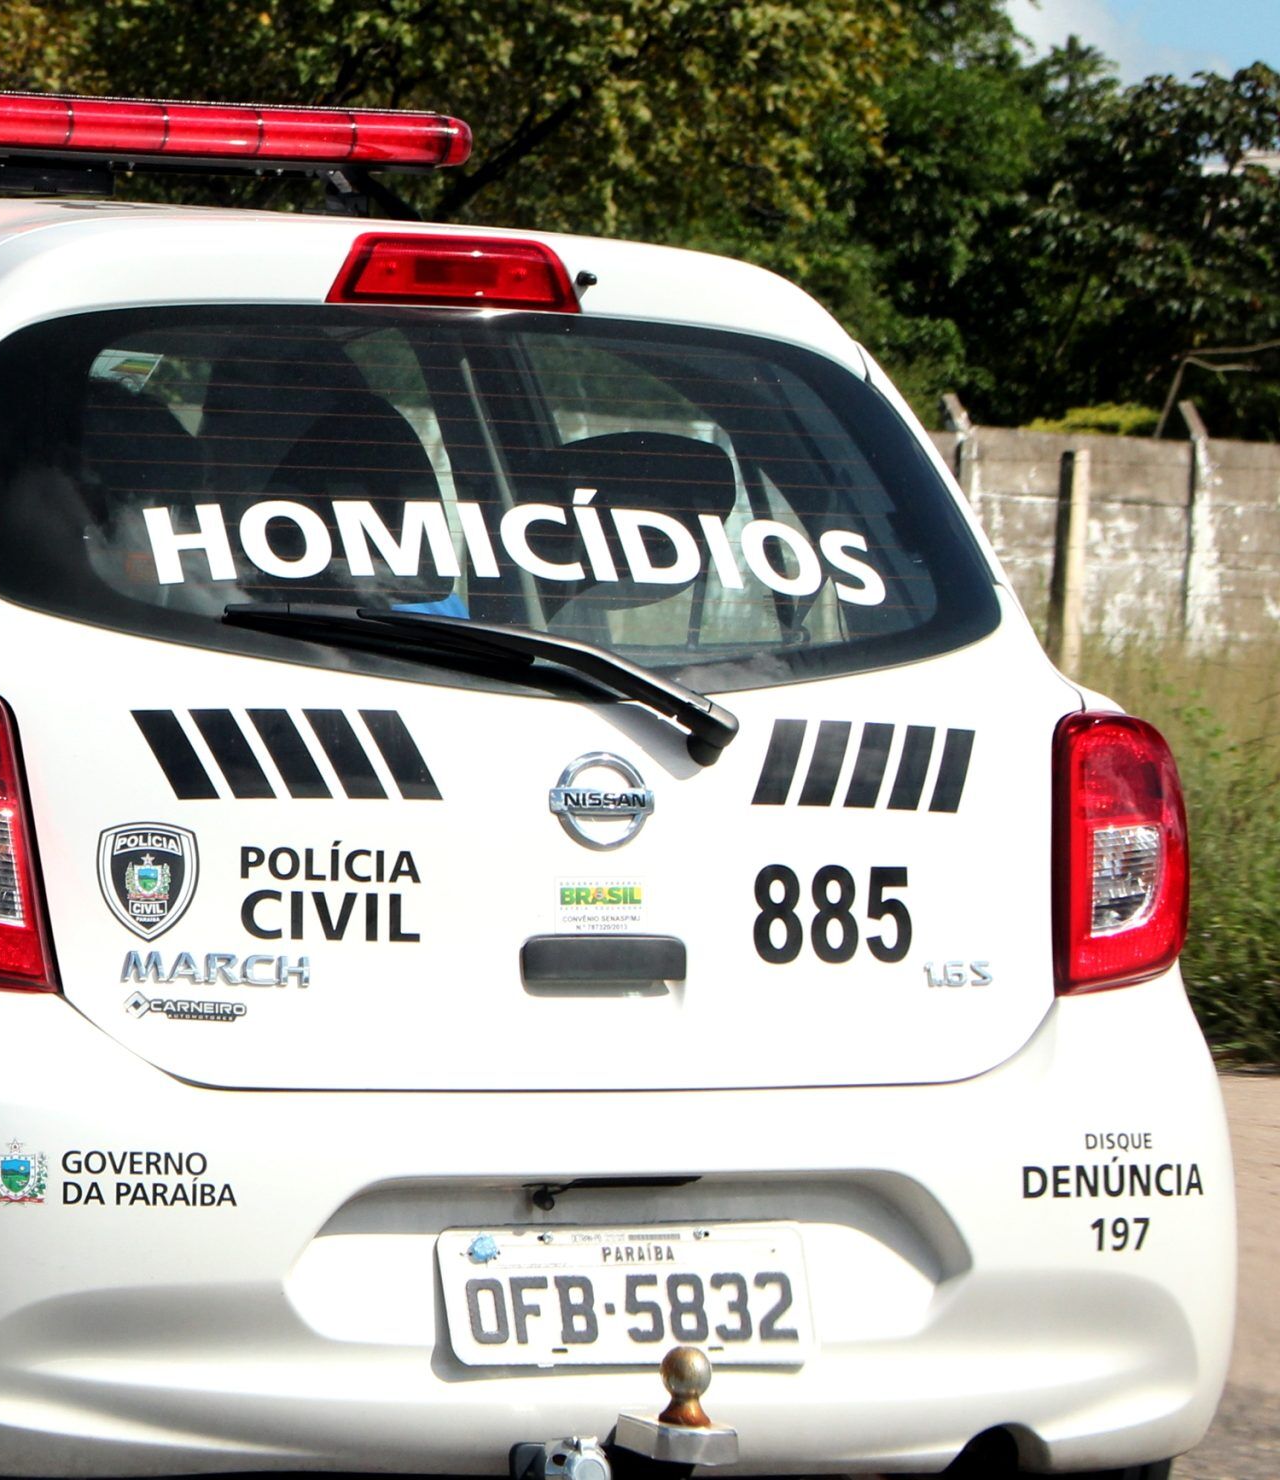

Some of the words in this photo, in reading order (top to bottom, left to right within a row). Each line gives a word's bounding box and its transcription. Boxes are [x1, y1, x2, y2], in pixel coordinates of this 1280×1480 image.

[143, 489, 886, 606] HOMICÍDIOS
[563, 792, 646, 808] NISSAN
[116, 832, 179, 852] POLÍCIA
[240, 841, 421, 883] POLÍCIA
[132, 903, 164, 914] CIVIL
[560, 887, 643, 905] BRASIL
[240, 889, 421, 943] CIVIL
[752, 863, 914, 966] 885
[120, 950, 311, 988] MARCH
[150, 1000, 247, 1016] CARNEIRO
[1084, 1132, 1153, 1153] DISQUE
[61, 1149, 208, 1177] GOVERNO
[62, 1181, 106, 1207] DA
[115, 1176, 238, 1209] PARAÍBA
[1022, 1156, 1205, 1201] DENÚNCIA
[1090, 1217, 1151, 1254] 197
[601, 1243, 675, 1263] PARAÍBA
